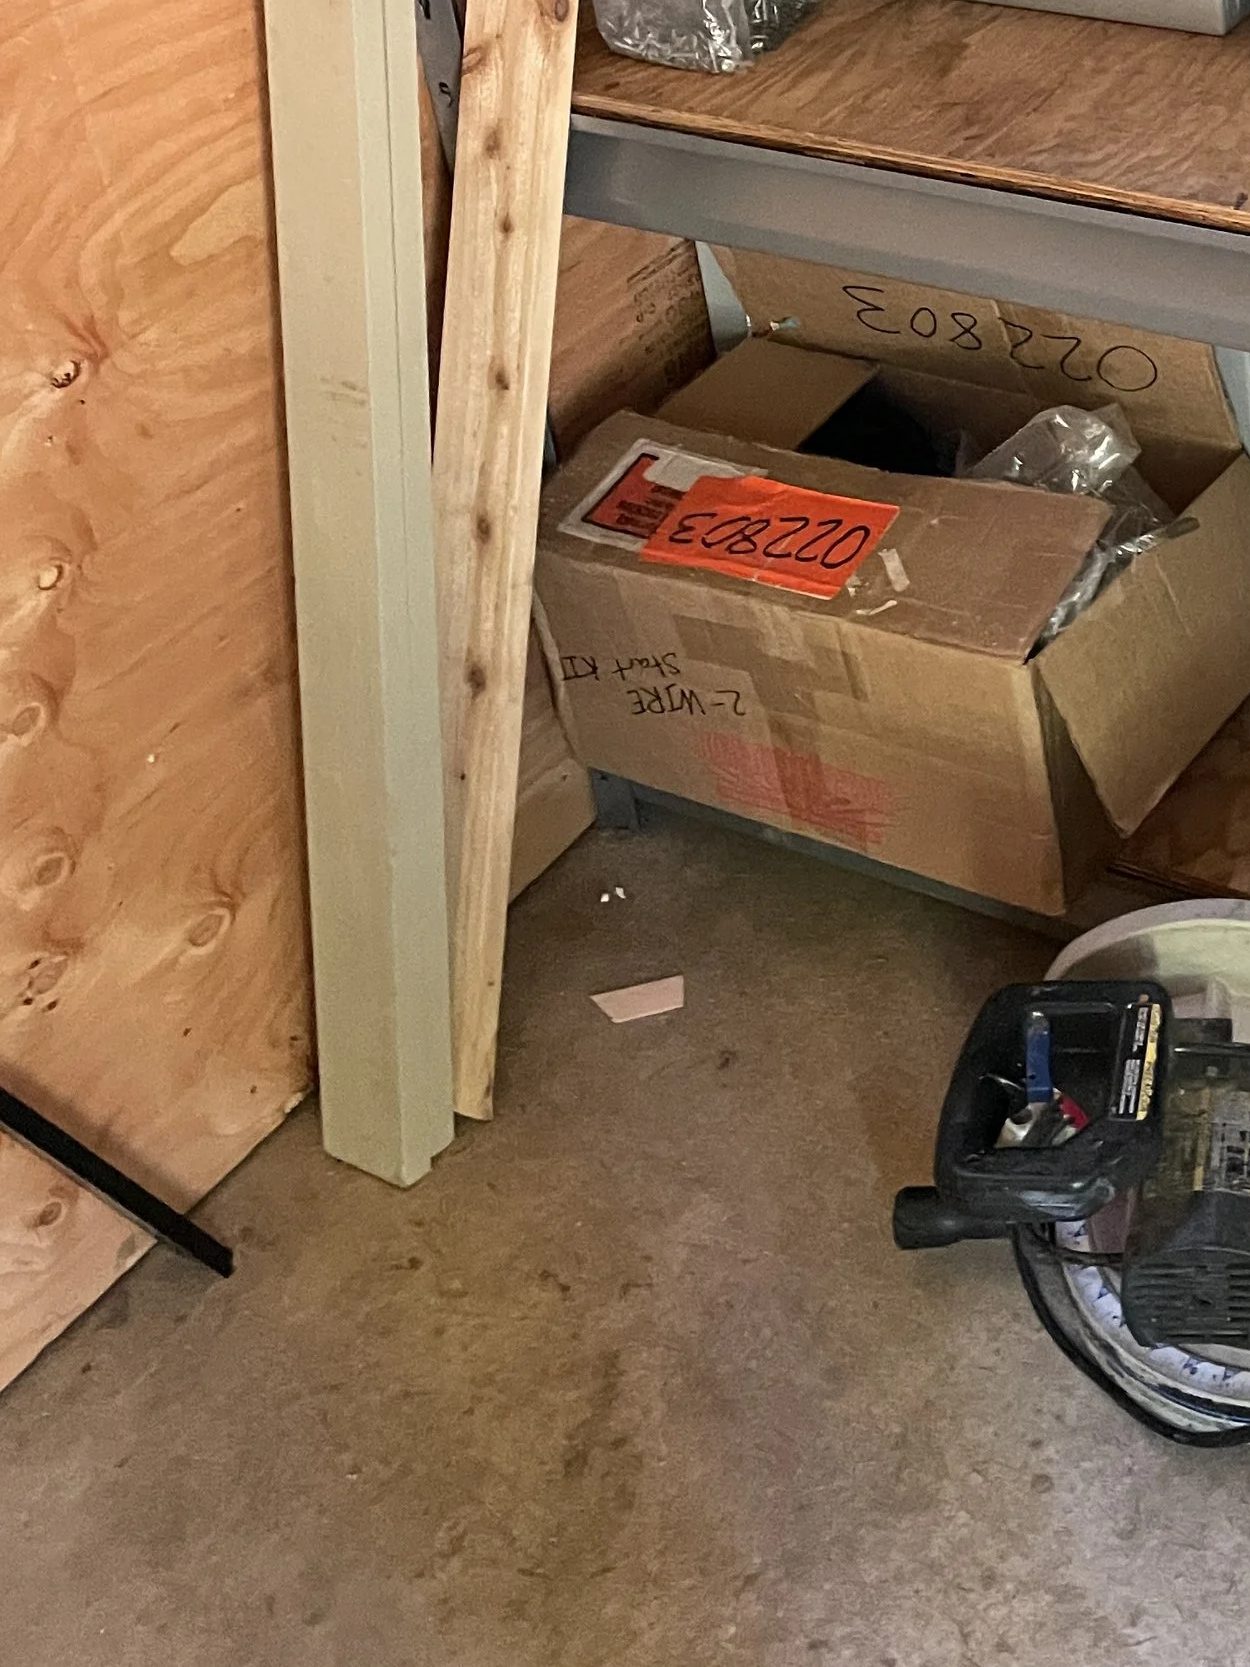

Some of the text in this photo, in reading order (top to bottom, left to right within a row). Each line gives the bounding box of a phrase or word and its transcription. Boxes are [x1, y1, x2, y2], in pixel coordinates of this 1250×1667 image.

[842, 285, 1158, 392] 022803
[668, 513, 871, 569] 022803
[612, 652, 682, 675] Start
[631, 685, 747, 718] 2-WIRE
